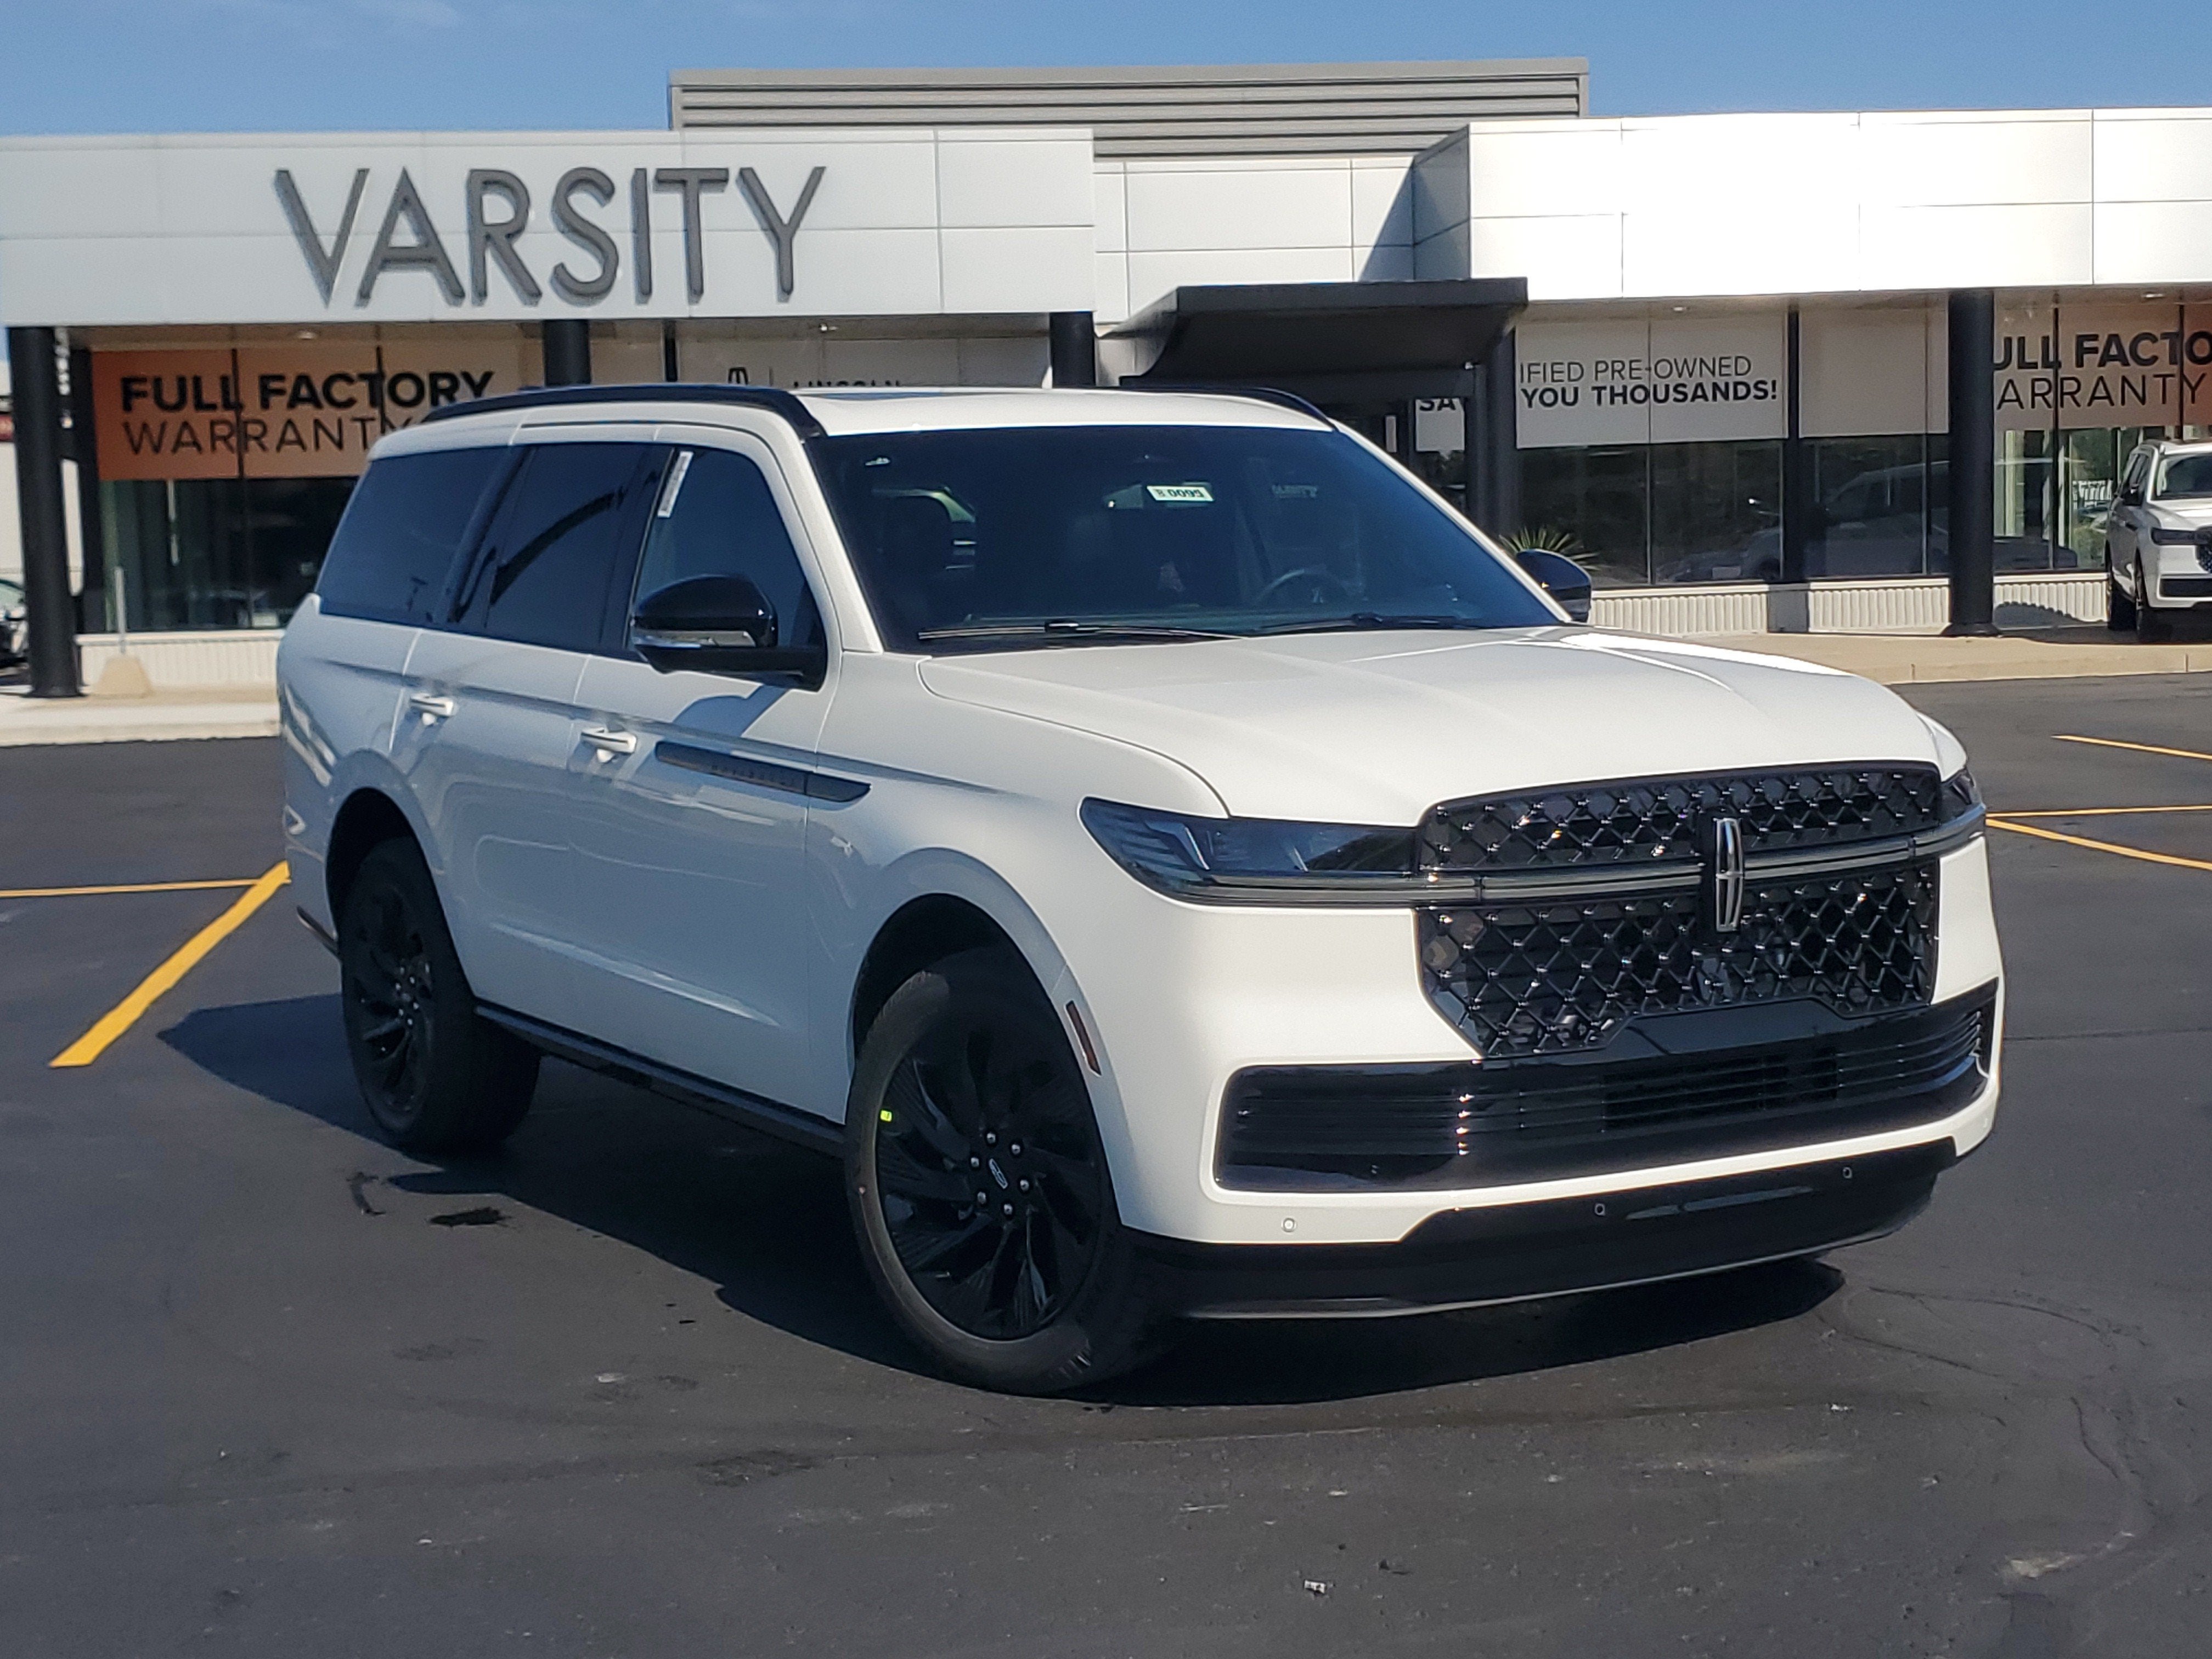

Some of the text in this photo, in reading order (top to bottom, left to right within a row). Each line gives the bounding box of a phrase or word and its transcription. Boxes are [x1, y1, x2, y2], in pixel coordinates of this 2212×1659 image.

[275, 166, 826, 308] VARSITY
[1520, 356, 1751, 383] IFIED PRE-OWNED
[121, 370, 495, 413] FULL FACTORY
[1521, 380, 1777, 408] YOU THOUSANDS!
